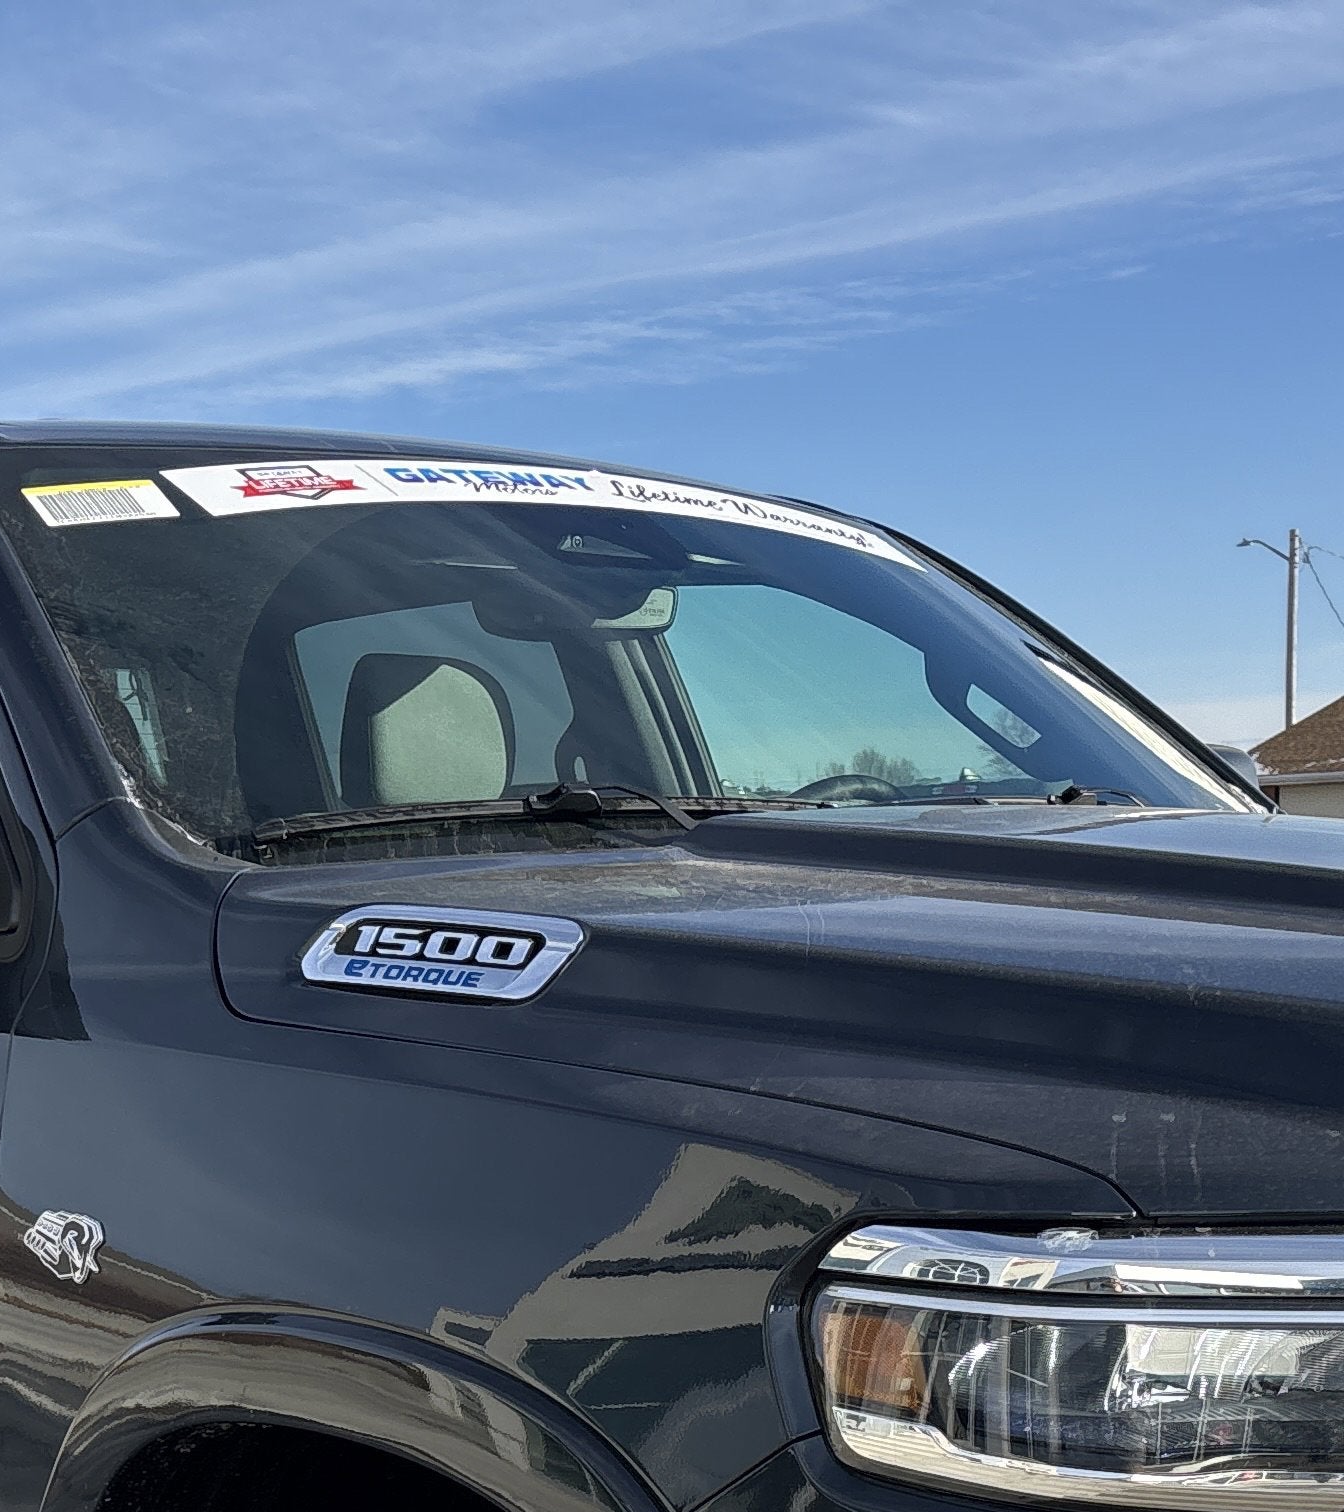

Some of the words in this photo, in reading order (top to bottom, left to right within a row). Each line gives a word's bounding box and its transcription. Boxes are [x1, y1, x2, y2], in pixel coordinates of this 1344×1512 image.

[248, 475, 338, 489] LIFETIME
[383, 468, 595, 492] GATEWAY
[609, 480, 723, 512] Lifetime
[353, 925, 536, 966] 1500
